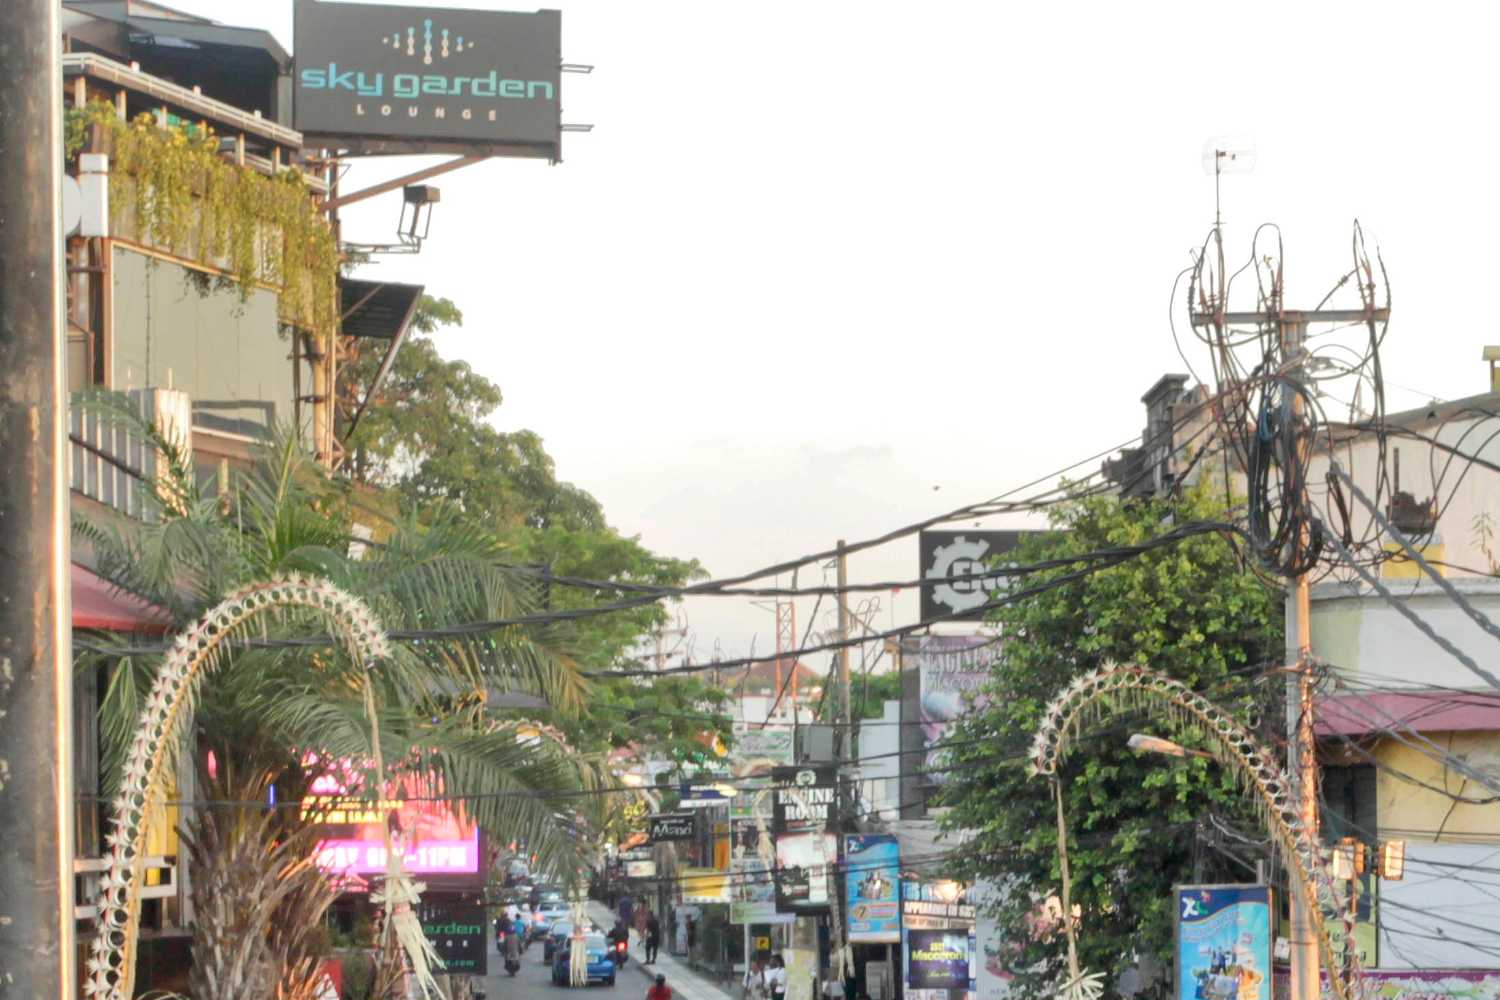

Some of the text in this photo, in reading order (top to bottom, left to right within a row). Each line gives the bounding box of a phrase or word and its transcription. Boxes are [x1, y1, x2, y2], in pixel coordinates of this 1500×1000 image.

[301, 62, 553, 99] sky garden
[357, 104, 496, 121] LOUNGE
